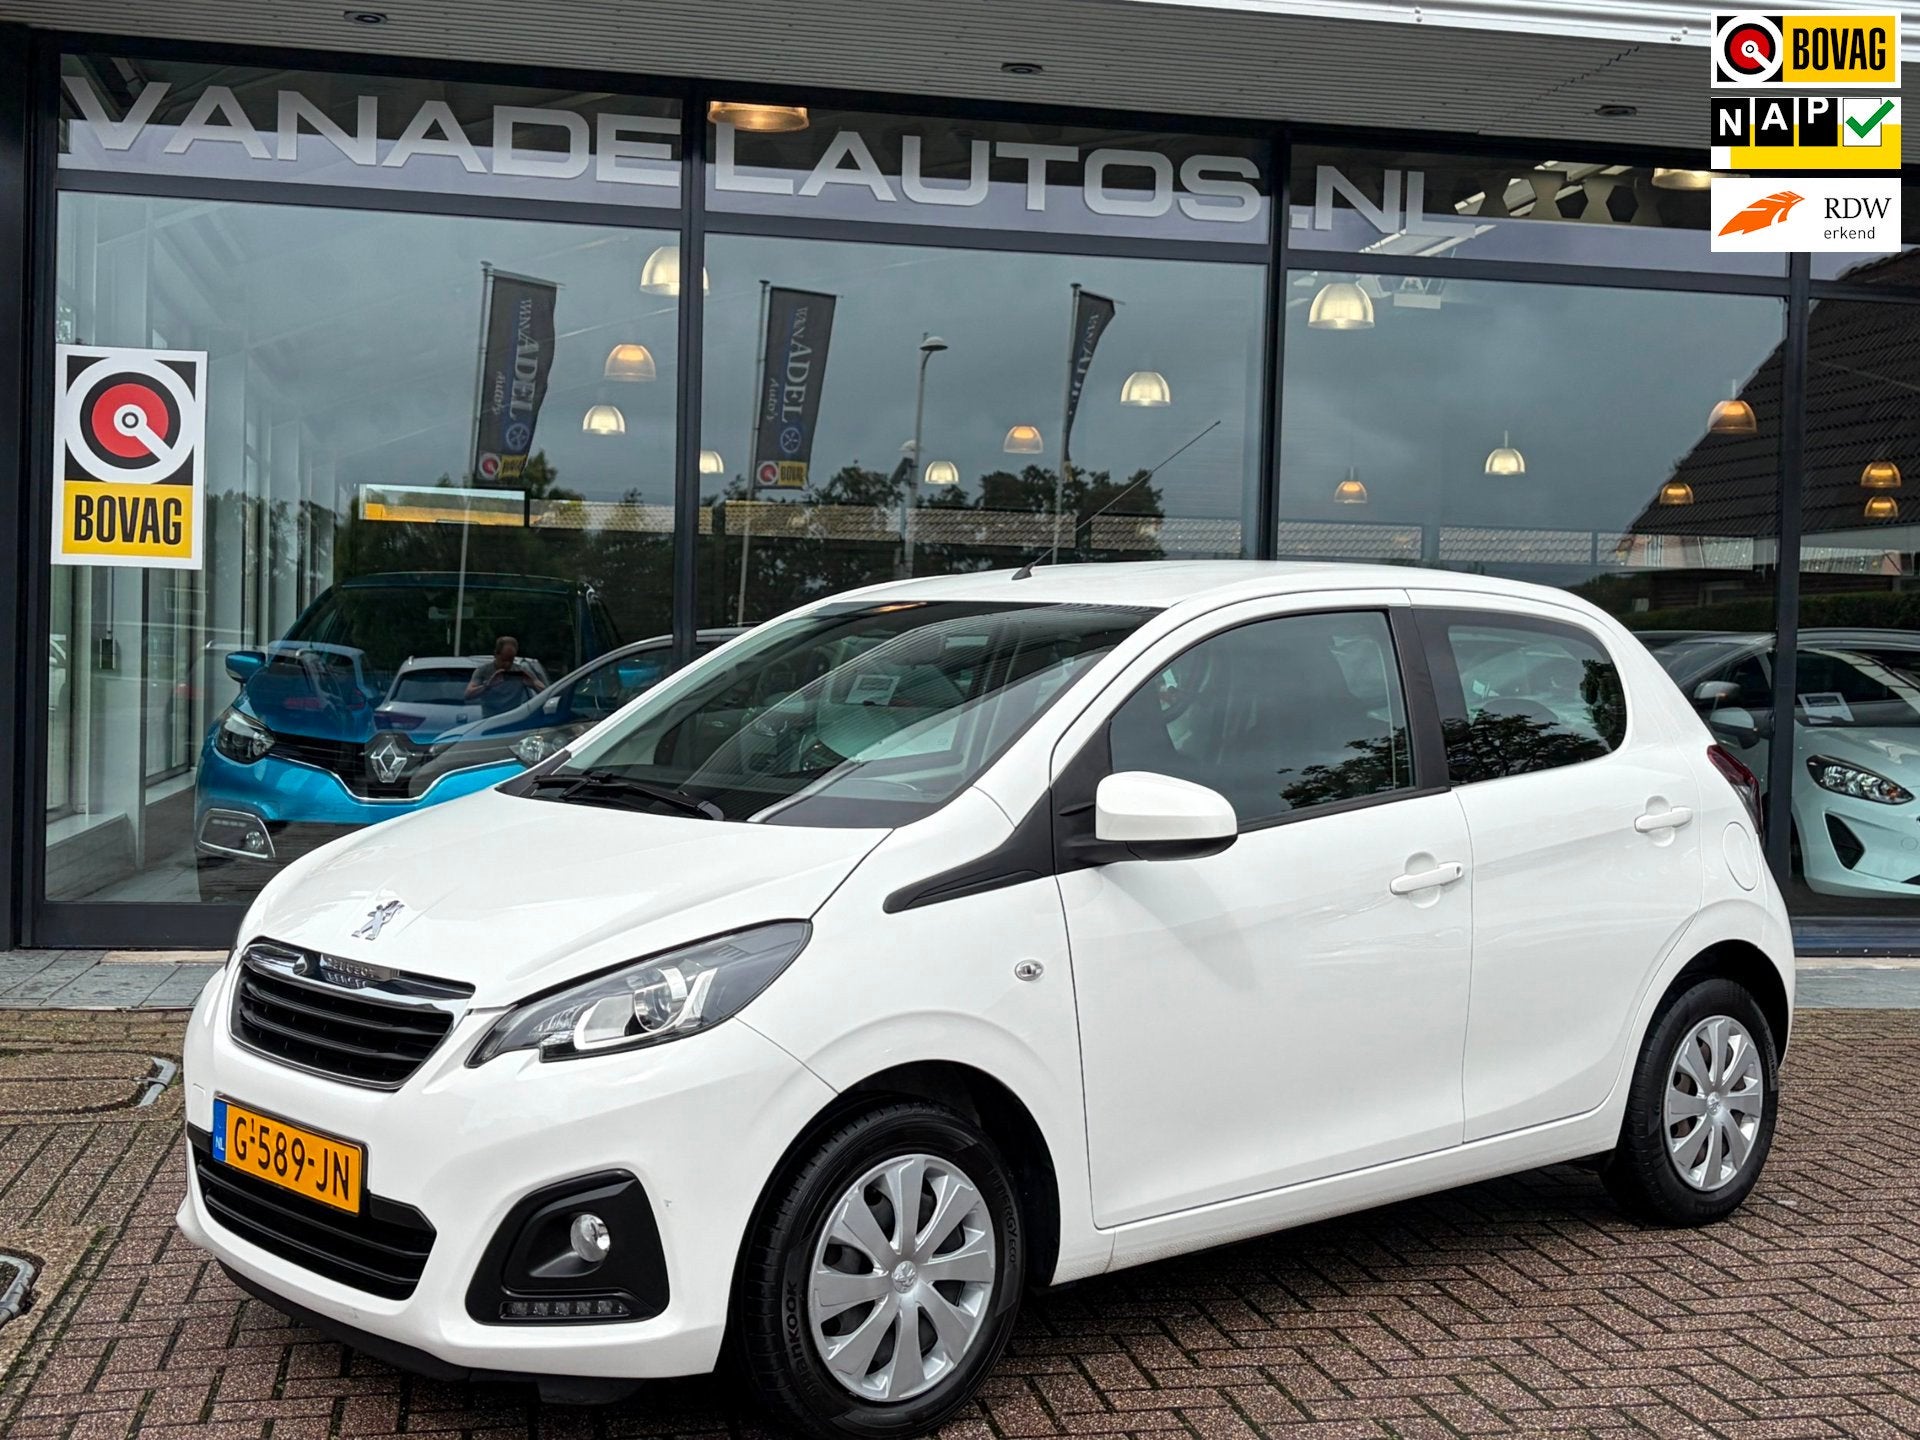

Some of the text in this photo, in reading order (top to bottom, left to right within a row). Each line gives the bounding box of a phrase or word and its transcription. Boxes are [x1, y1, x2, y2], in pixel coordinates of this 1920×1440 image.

[73, 494, 182, 545] BOVAG
[215, 1136, 225, 1151] NL
[234, 1116, 349, 1201] G-589-JN
